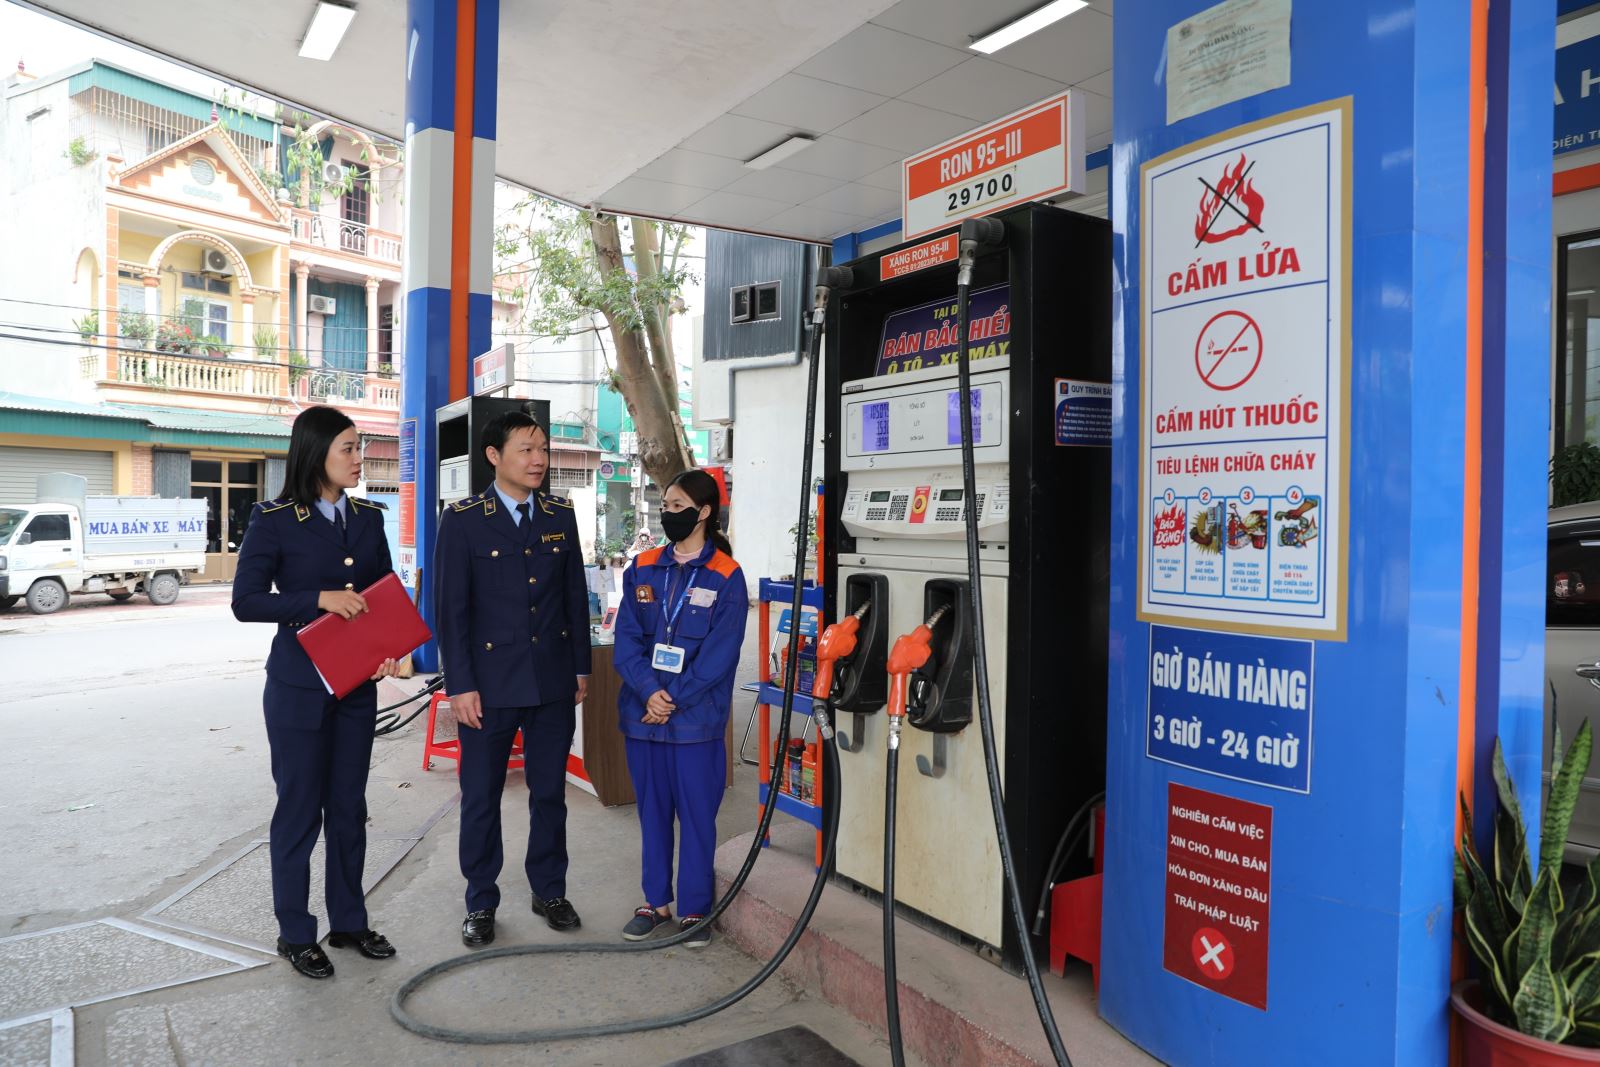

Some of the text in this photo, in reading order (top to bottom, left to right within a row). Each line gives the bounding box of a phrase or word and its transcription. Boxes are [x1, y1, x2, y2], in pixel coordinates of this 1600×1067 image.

[940, 128, 1022, 183] RON 95-III
[948, 173, 1013, 211] 29700
[889, 240, 949, 268] XĂNG RON 95-III
[1167, 240, 1301, 297] CẤM LỬA
[933, 307, 949, 321] TẠI
[882, 331, 922, 359] BÁN
[887, 360, 898, 375] Ô
[903, 355, 923, 373] TÔ
[968, 341, 1010, 361] MÁY
[1071, 385, 1084, 393] QUY
[1156, 394, 1319, 435] CẤM HÚT THUỐC
[1157, 449, 1316, 477] TIÊU LỆNH CHỮA CHÁY
[1167, 493, 1172, 501] 1
[1202, 492, 1208, 500] 2
[1243, 491, 1250, 500] 3
[1290, 491, 1299, 500] 4
[89, 516, 204, 535] MUA BÁN XE MÁY
[1160, 517, 1175, 530] BÁO
[1152, 646, 1307, 710] GIỜ BÁN HÀNG
[1153, 714, 1299, 769] 3 GIỜ - 24 GIỜ
[1172, 805, 1265, 840] NGHIÊM CẤM VIỆC
[1170, 834, 1267, 873] XIN CHO, MUA BÁN
[1168, 863, 1267, 903] HÓA ĐƠN XĂNG DẦU
[1174, 893, 1259, 932] TRÁI PHÁP LUẬT
